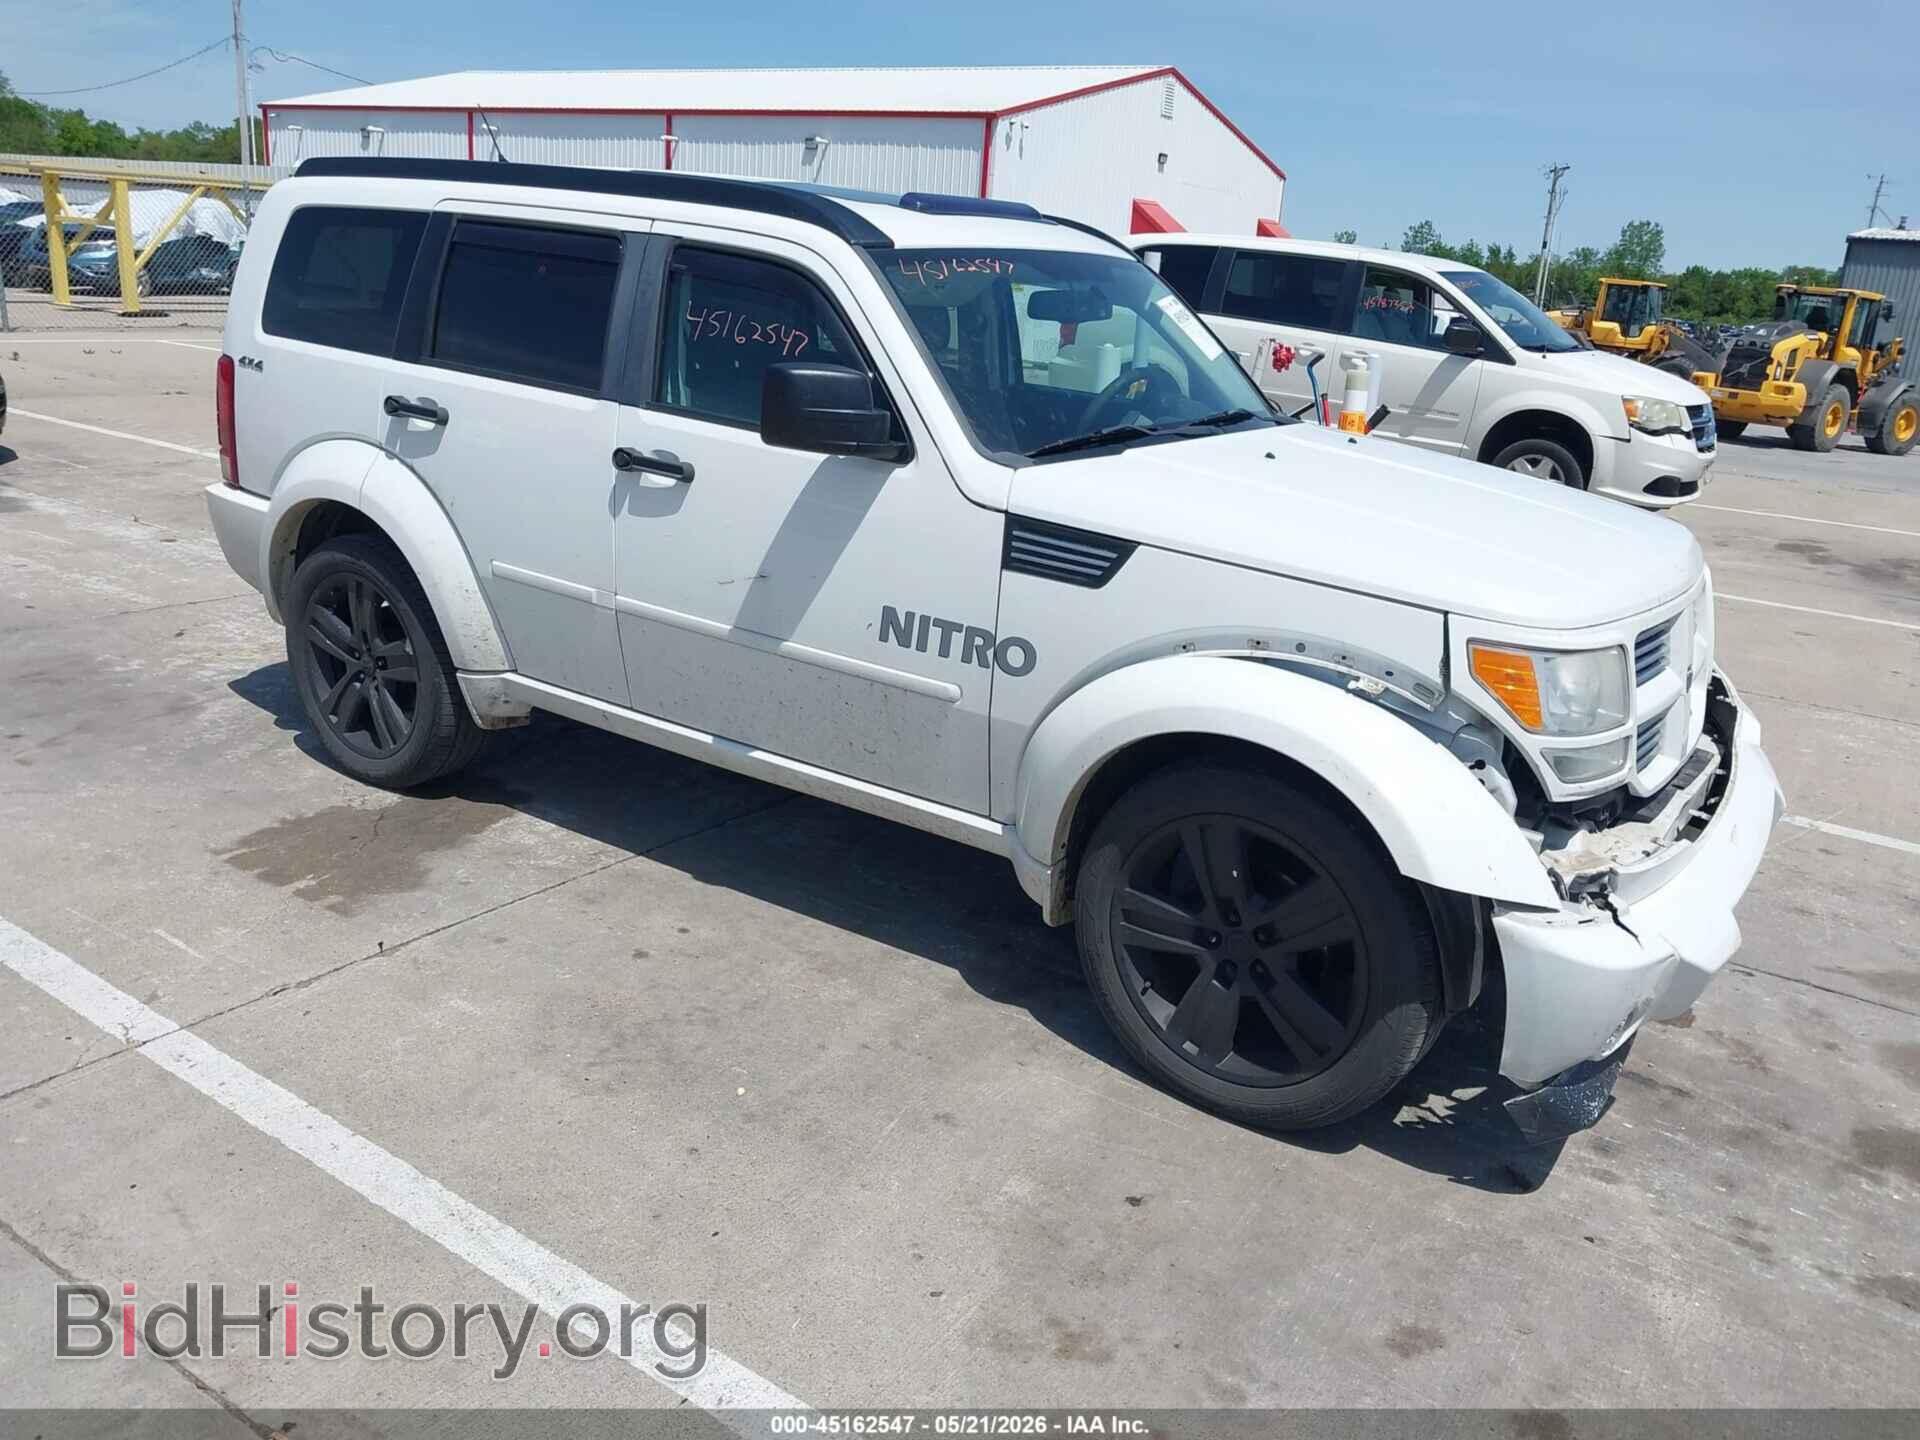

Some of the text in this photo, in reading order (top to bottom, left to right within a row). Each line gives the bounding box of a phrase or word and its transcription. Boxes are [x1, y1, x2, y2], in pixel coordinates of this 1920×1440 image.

[898, 257, 1013, 286] 45162547
[686, 300, 809, 356] 45162547
[878, 604, 1037, 677] NITRO
